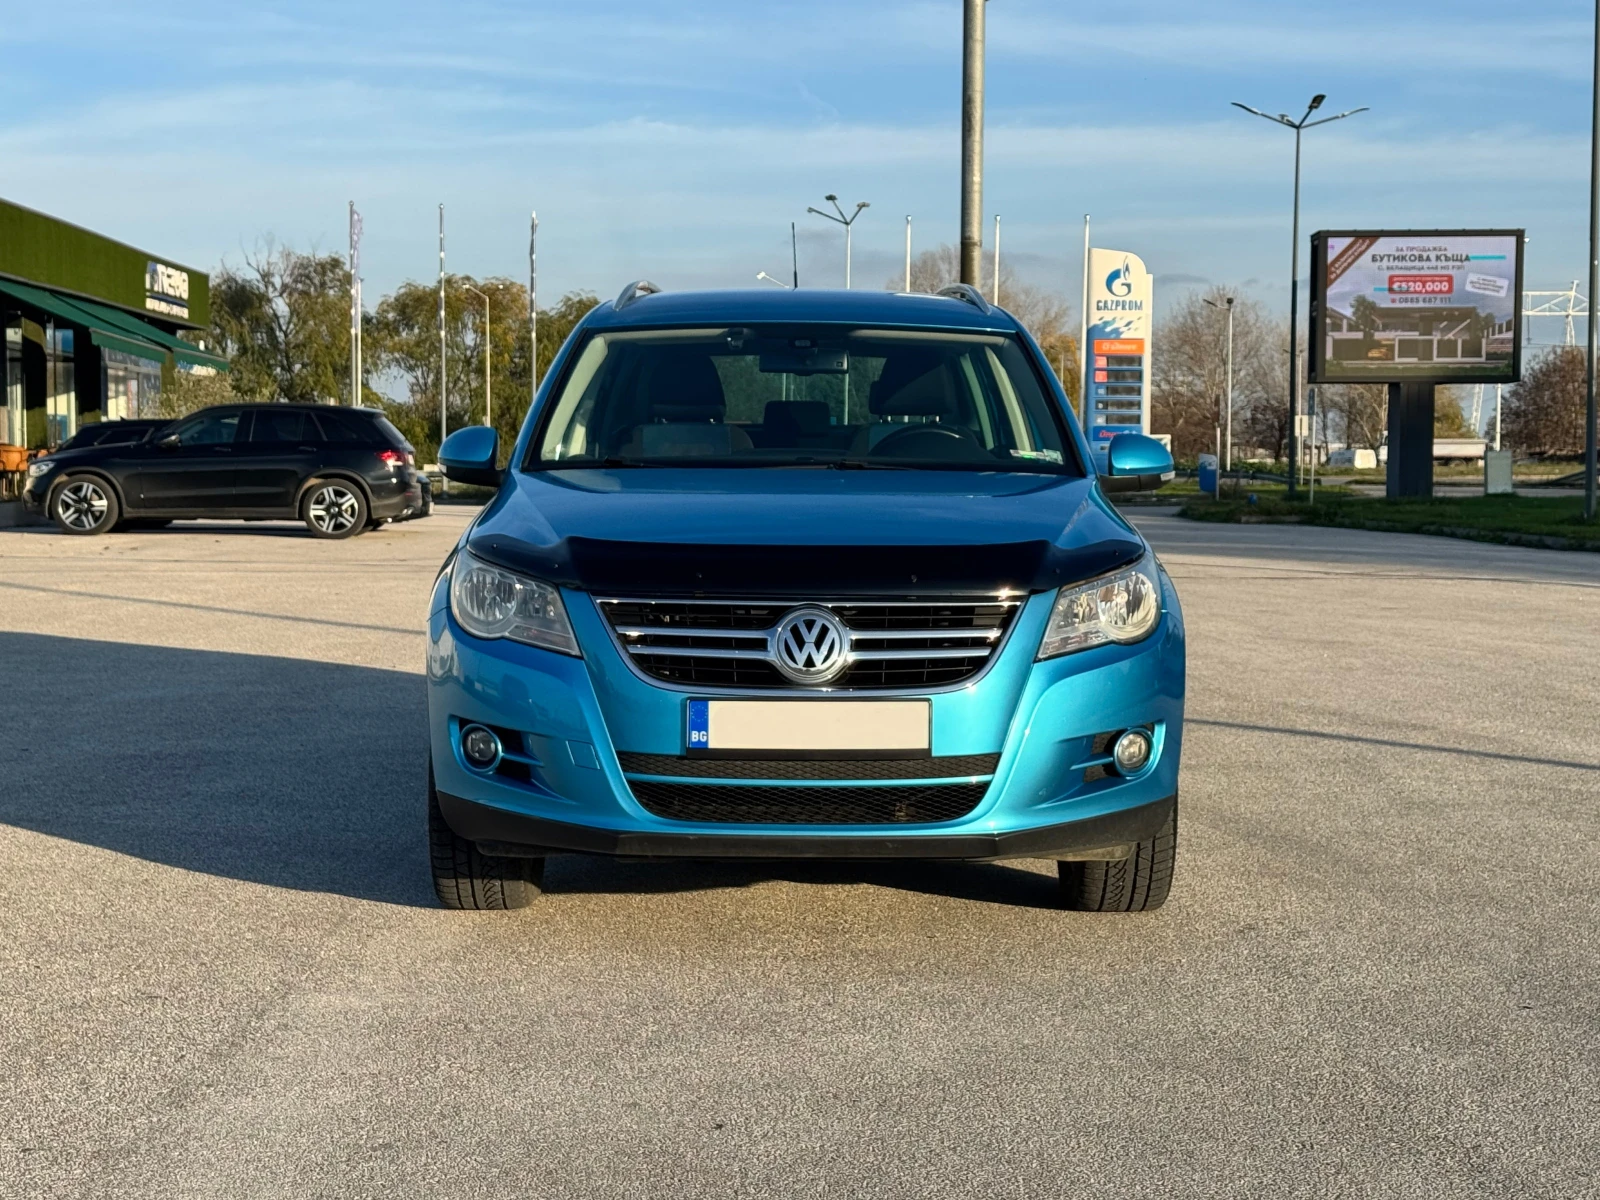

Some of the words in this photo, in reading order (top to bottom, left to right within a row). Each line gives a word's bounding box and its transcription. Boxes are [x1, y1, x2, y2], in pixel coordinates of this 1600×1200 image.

[1371, 254, 1432, 262] БУТИКОВА
[1435, 254, 1471, 263] КЪЩА
[1392, 281, 1450, 294] €520,000
[1096, 299, 1144, 311] GAZPROM
[691, 731, 707, 742] BG
